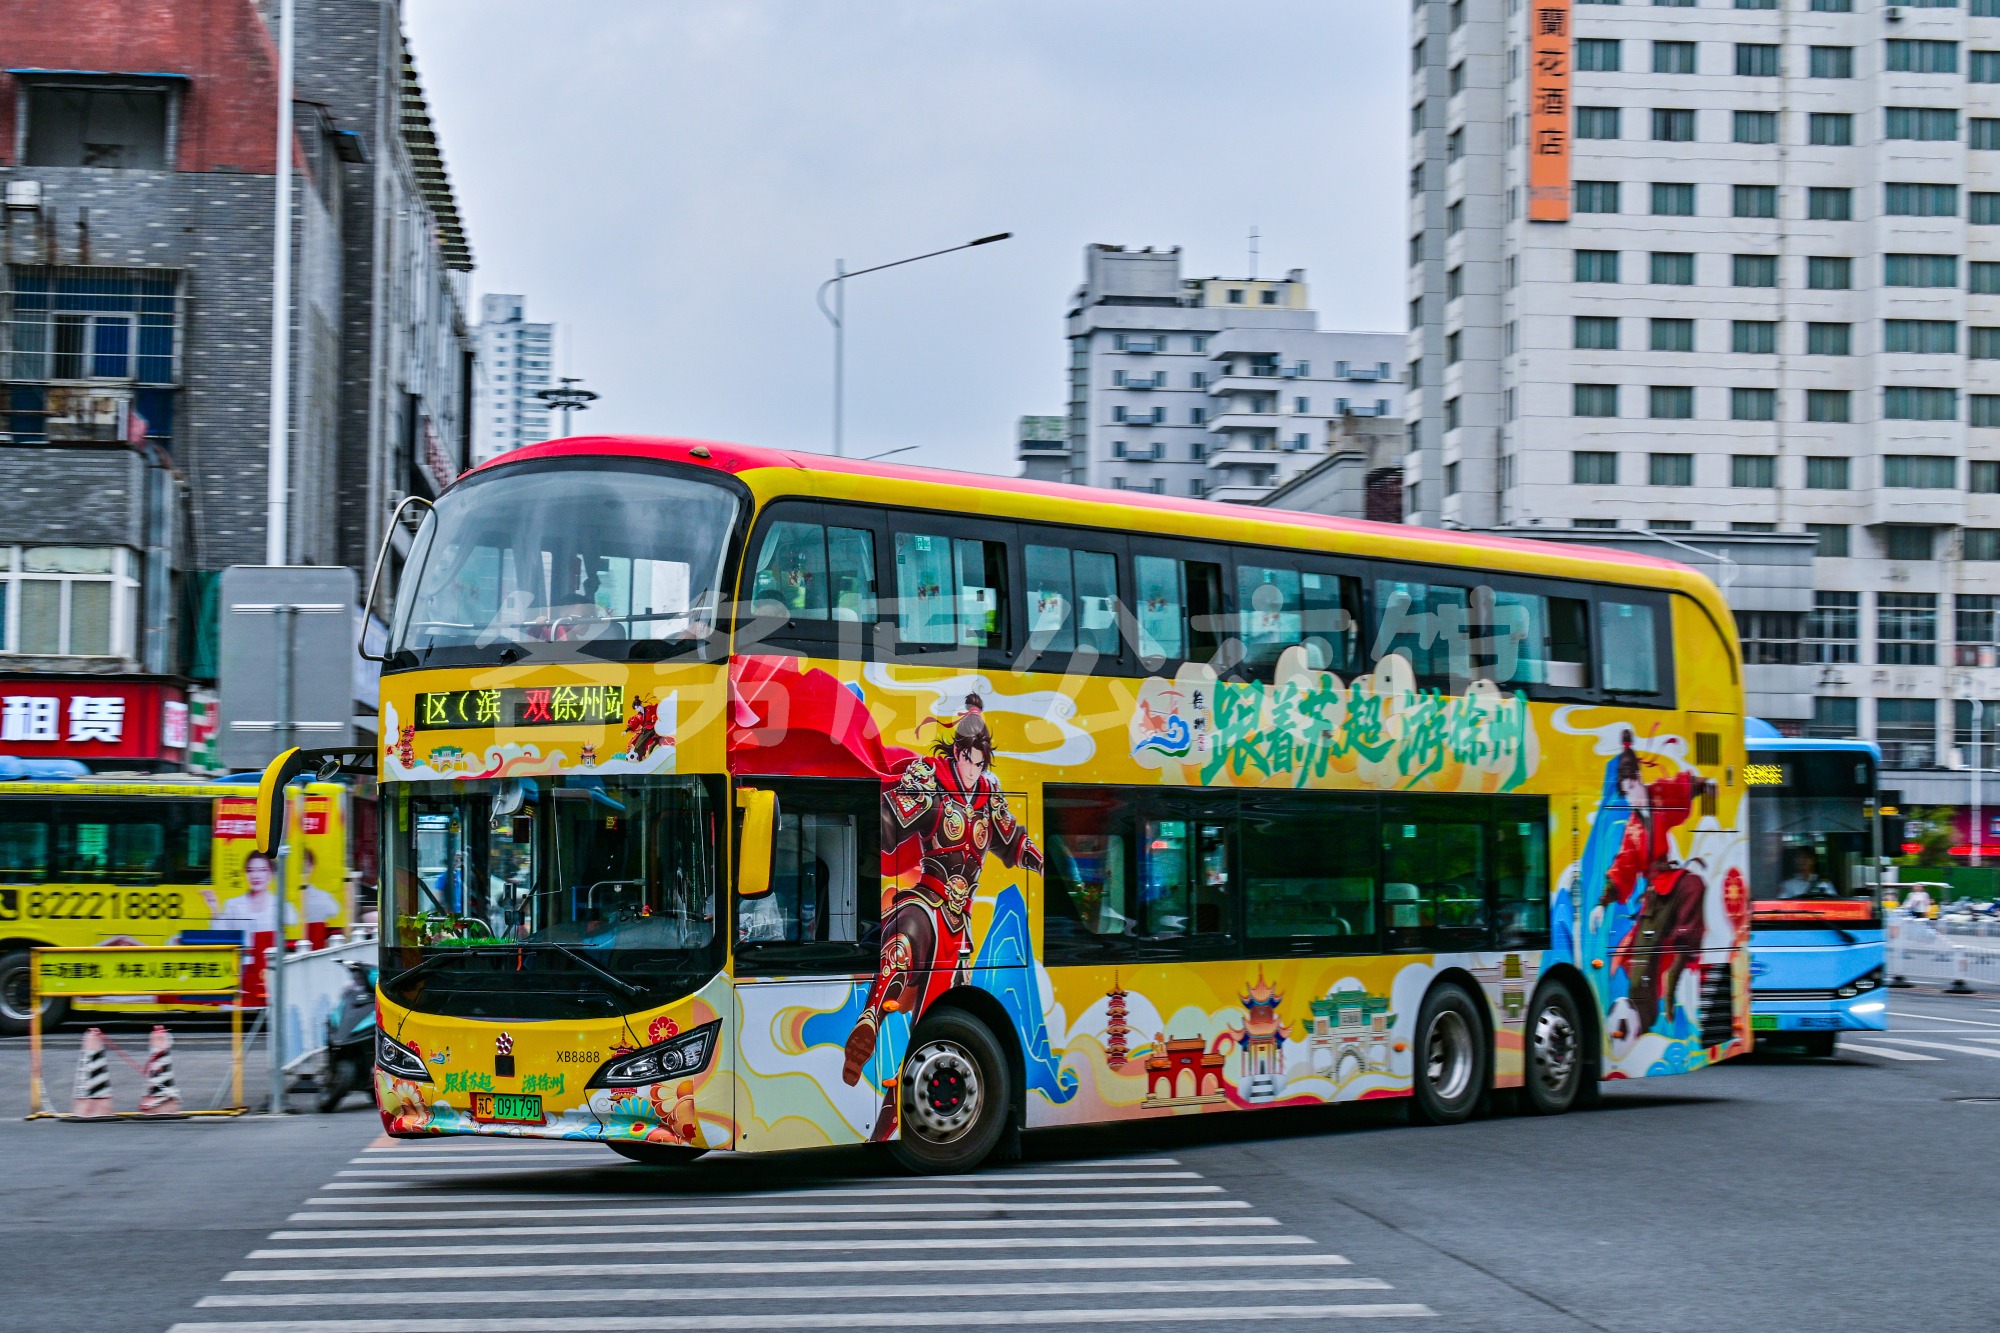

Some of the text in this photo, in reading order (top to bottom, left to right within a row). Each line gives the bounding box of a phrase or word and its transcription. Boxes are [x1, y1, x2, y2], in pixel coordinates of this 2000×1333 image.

[0, 695, 125, 742] 租赁
[26, 892, 183, 919] 82221888
[556, 1050, 600, 1063] XB8888
[443, 1069, 566, 1097] 跟着苏超 游徐州
